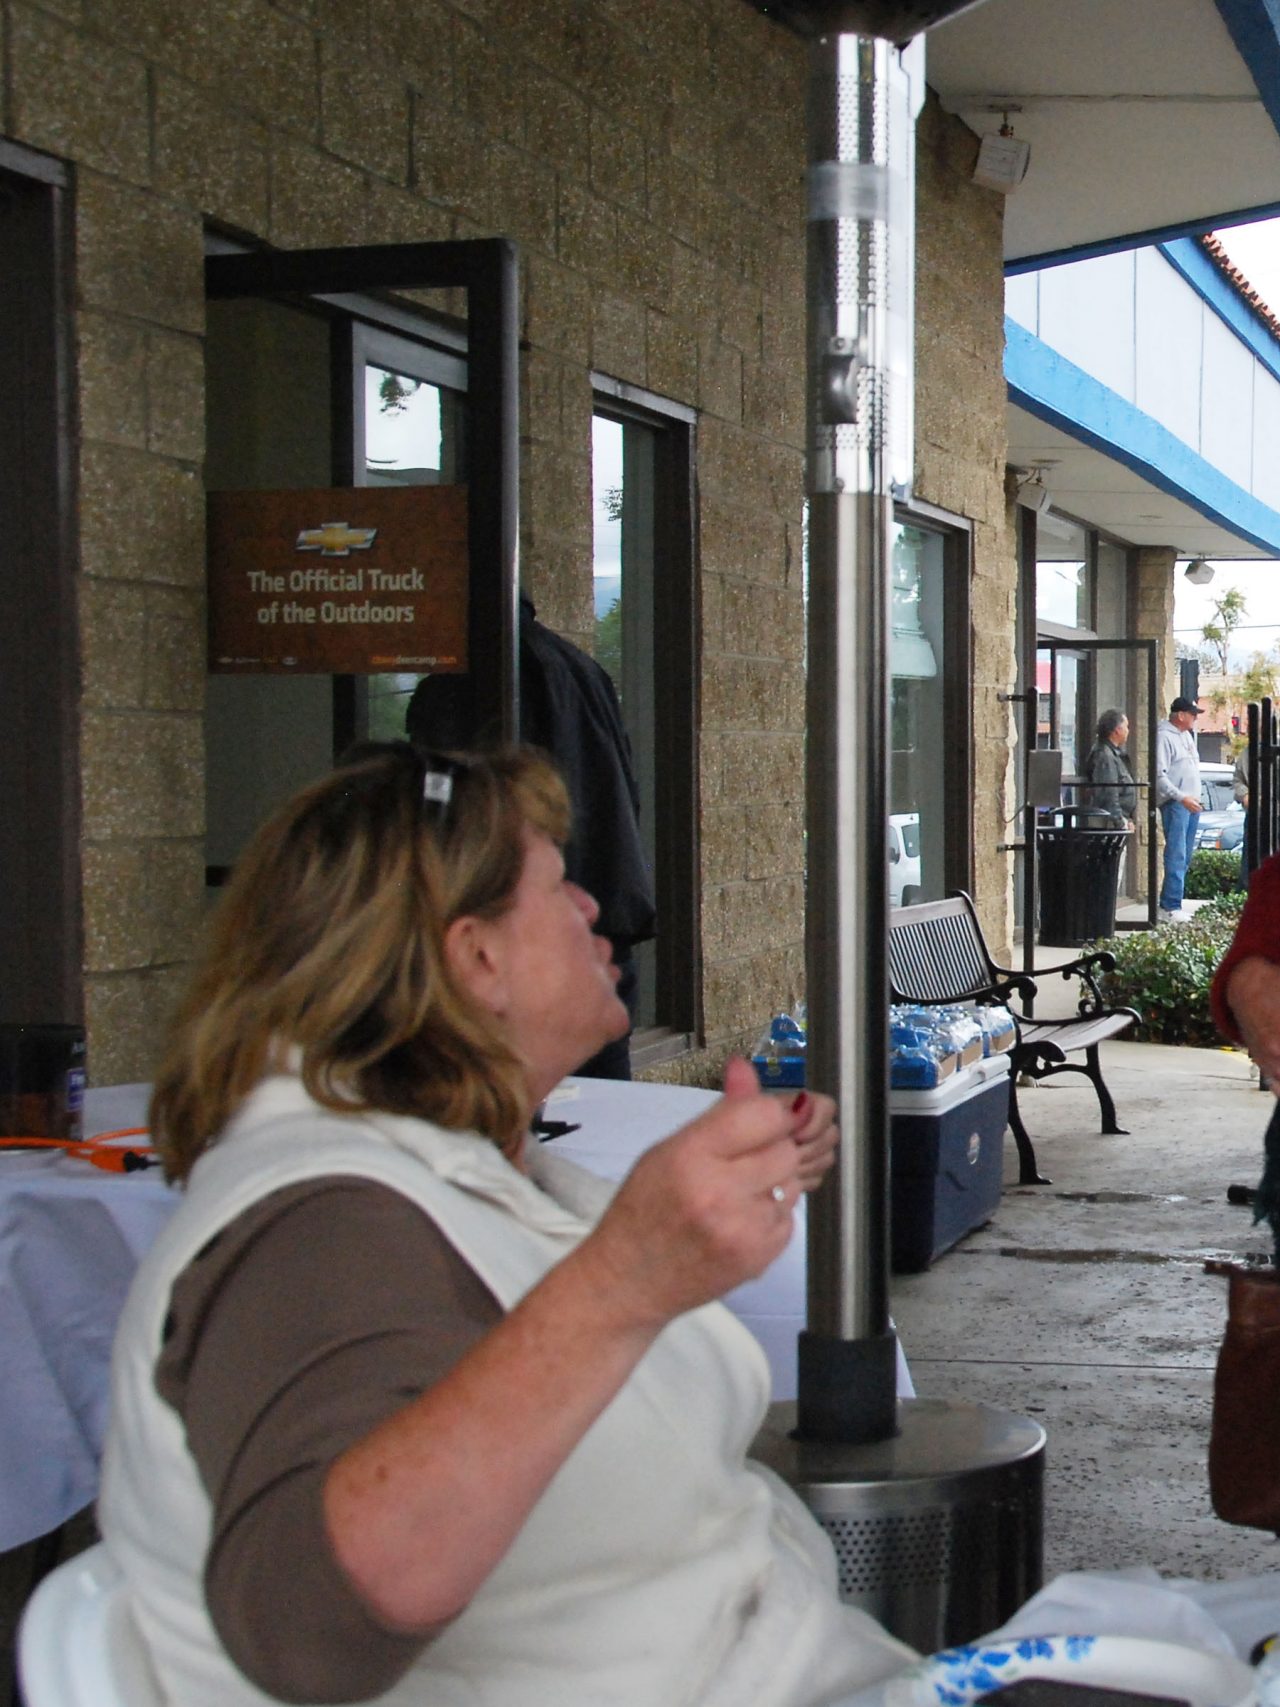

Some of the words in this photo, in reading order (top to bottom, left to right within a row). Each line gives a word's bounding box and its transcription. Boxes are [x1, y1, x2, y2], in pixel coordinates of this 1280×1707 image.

[247, 571, 284, 592] The
[290, 568, 362, 592] Official
[368, 568, 424, 591] Truck
[257, 601, 277, 625] of
[283, 601, 315, 624] the
[321, 600, 414, 624] Outdoors
